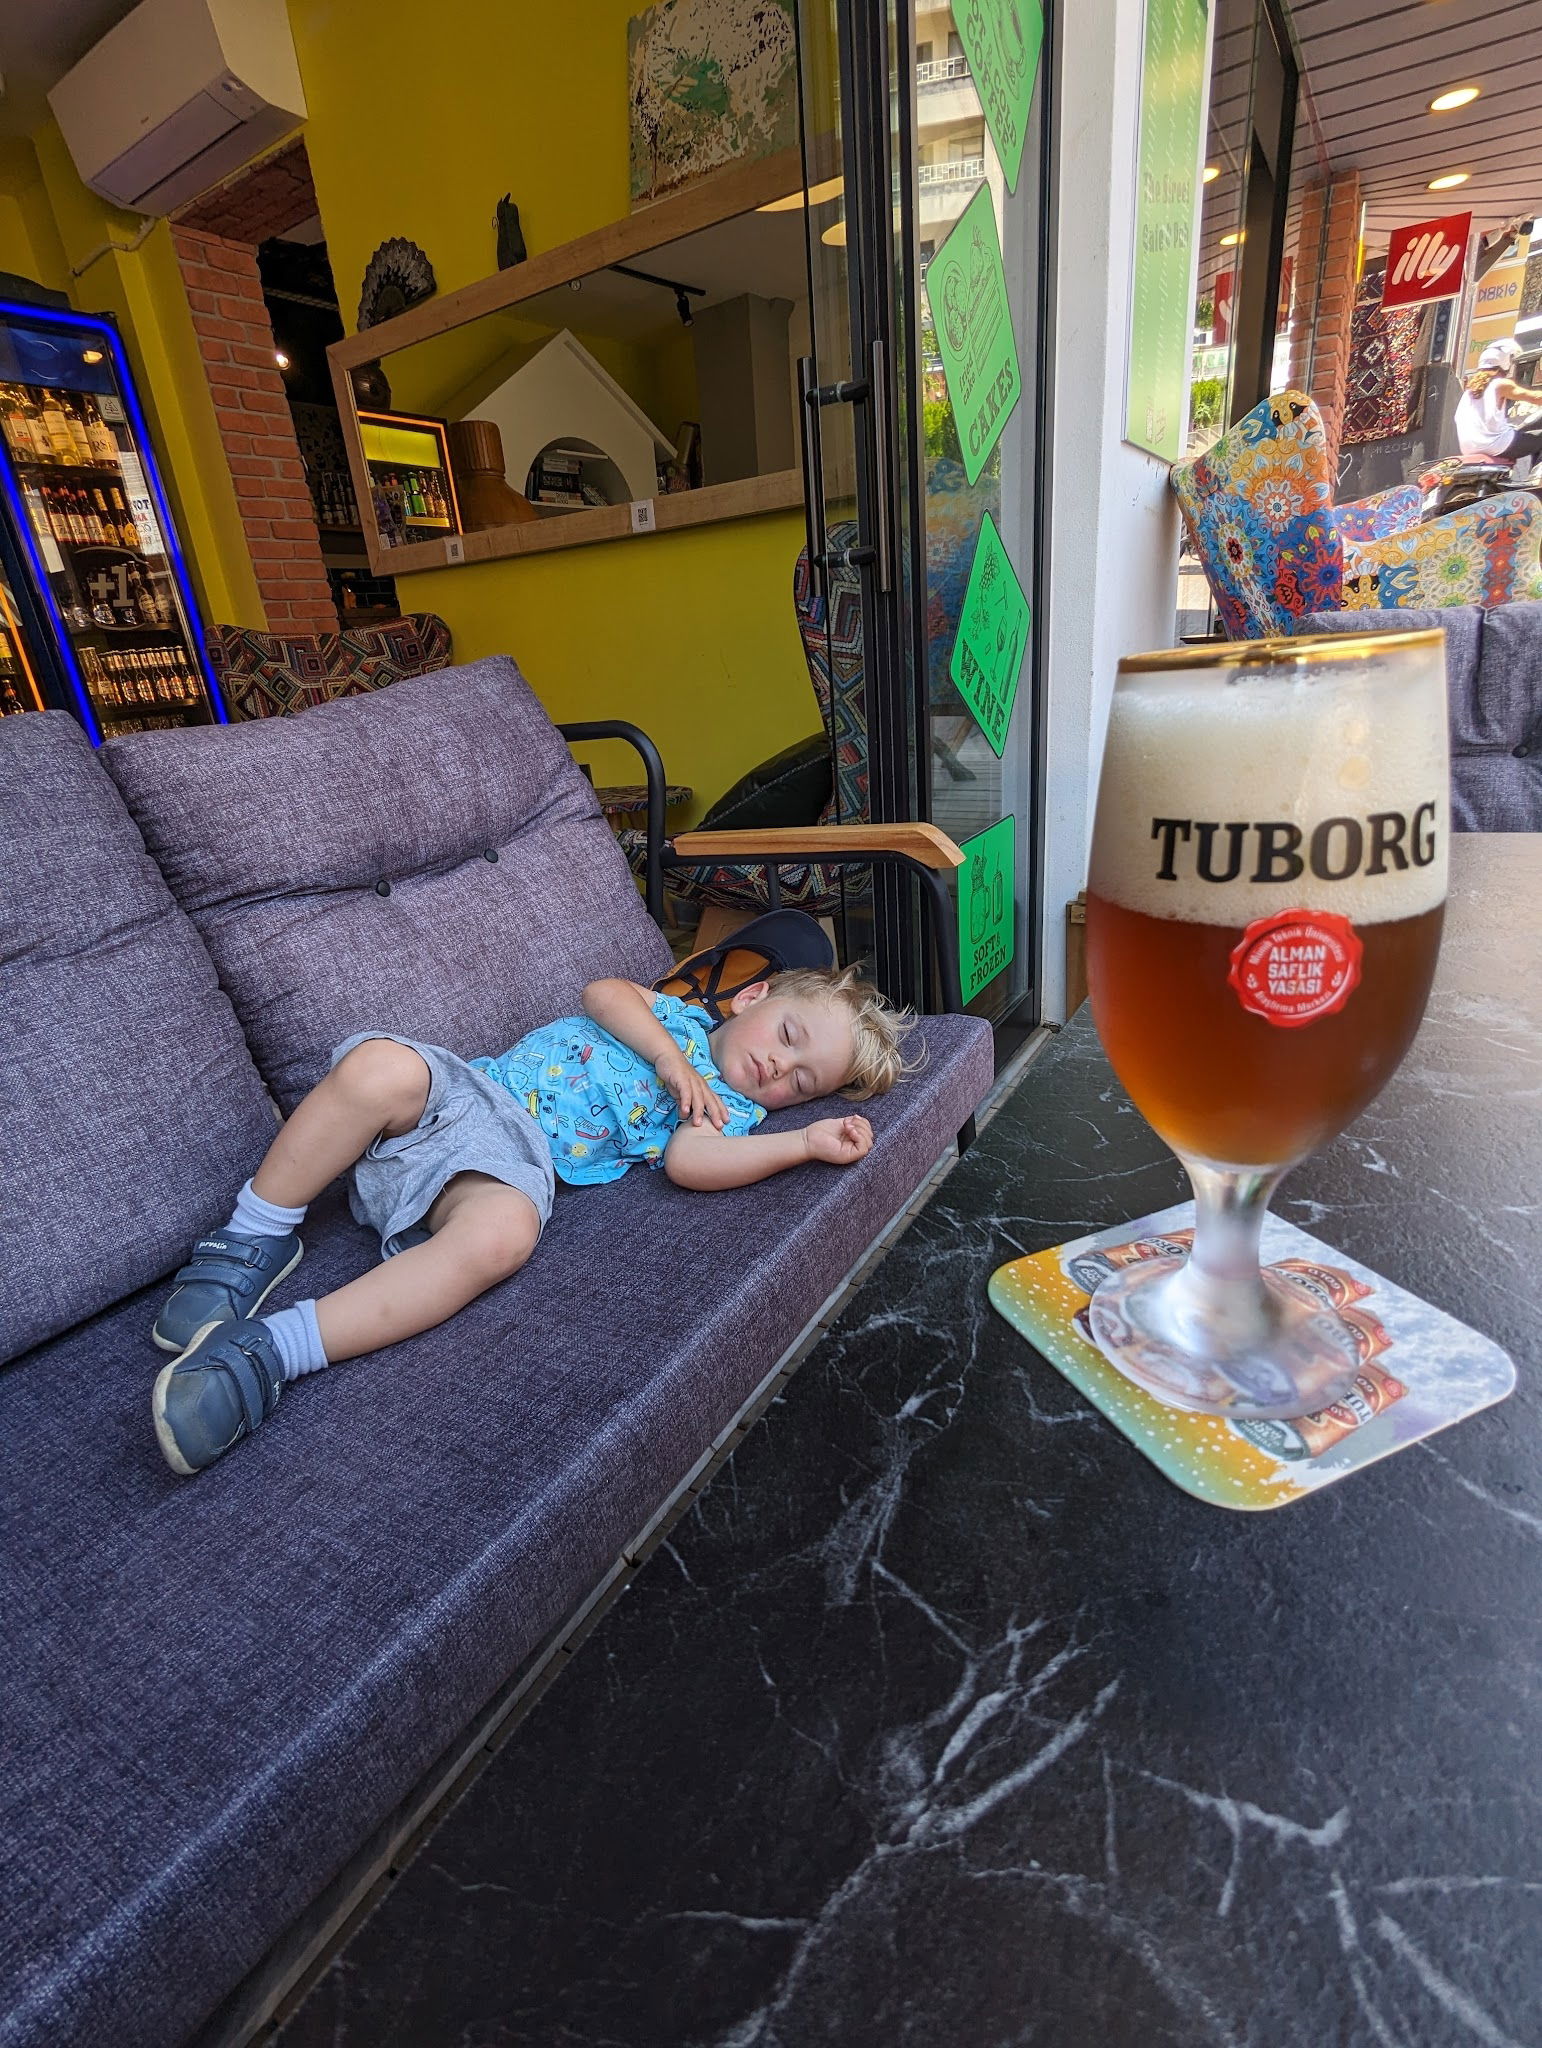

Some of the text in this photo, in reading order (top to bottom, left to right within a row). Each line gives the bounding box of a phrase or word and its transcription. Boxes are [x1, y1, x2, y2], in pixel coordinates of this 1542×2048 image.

[966, 13, 1009, 157] COFFEE
[994, 68, 1017, 148] COLD
[1391, 231, 1461, 290] illy
[969, 357, 1014, 457] CAKES
[960, 638, 1005, 743] WINE
[1150, 800, 1436, 884] TUBORG
[969, 944, 1007, 991] FROZEN
[973, 934, 998, 968] SOFT
[1267, 961, 1324, 979] SAFLIK
[1268, 945, 1326, 962] ALMAN
[1267, 978, 1322, 996] YASASI
[1307, 1267, 1342, 1291] GOLD
